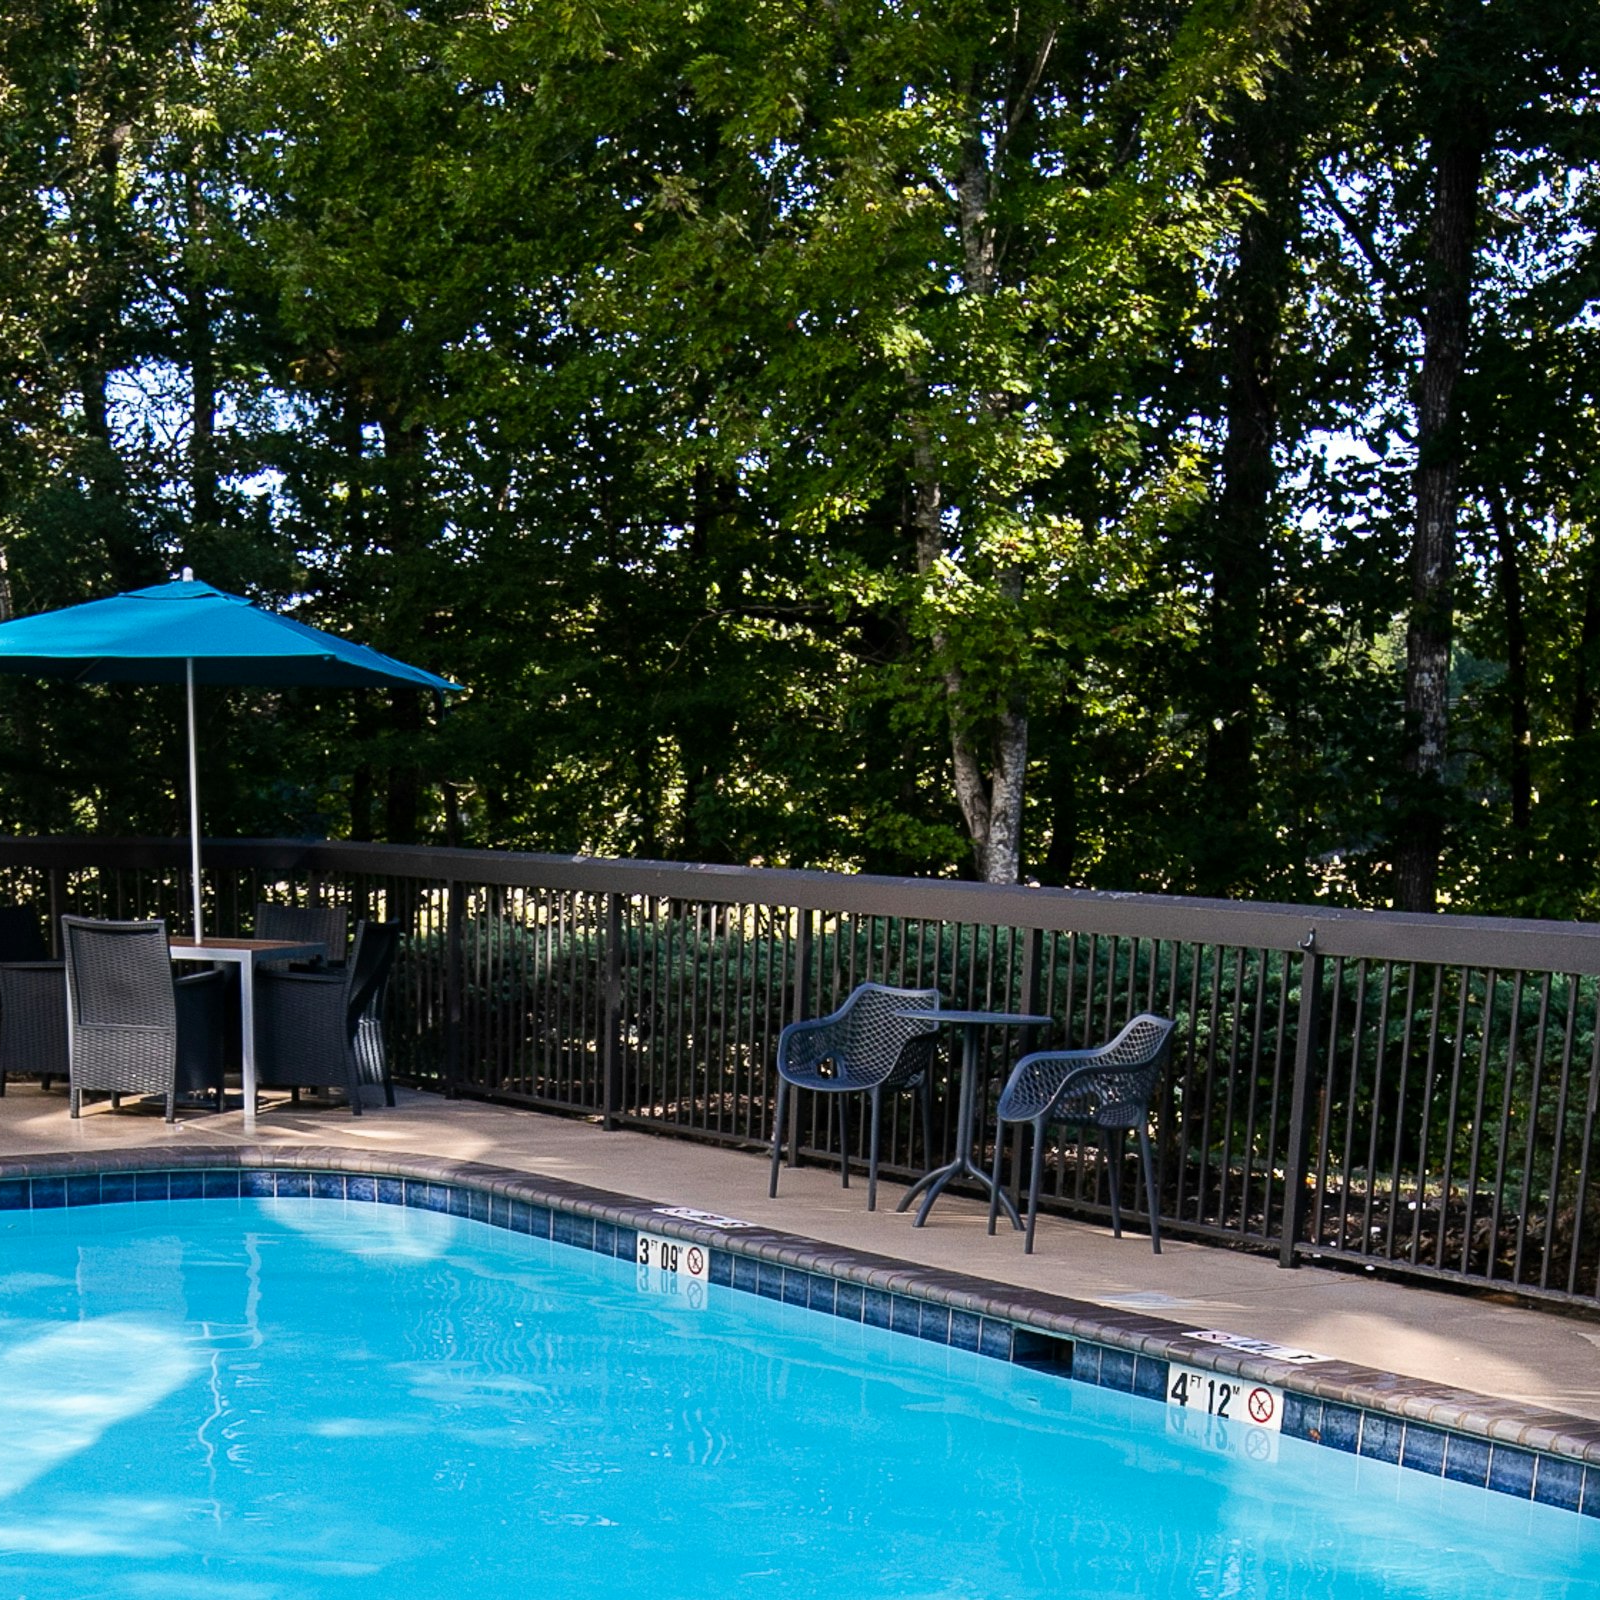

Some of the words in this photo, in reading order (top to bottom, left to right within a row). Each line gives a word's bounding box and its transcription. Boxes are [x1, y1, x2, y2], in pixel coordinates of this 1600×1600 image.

[640, 1238, 649, 1265] 3
[1171, 1372, 1189, 1406] 4
[1190, 1374, 1202, 1388] FT
